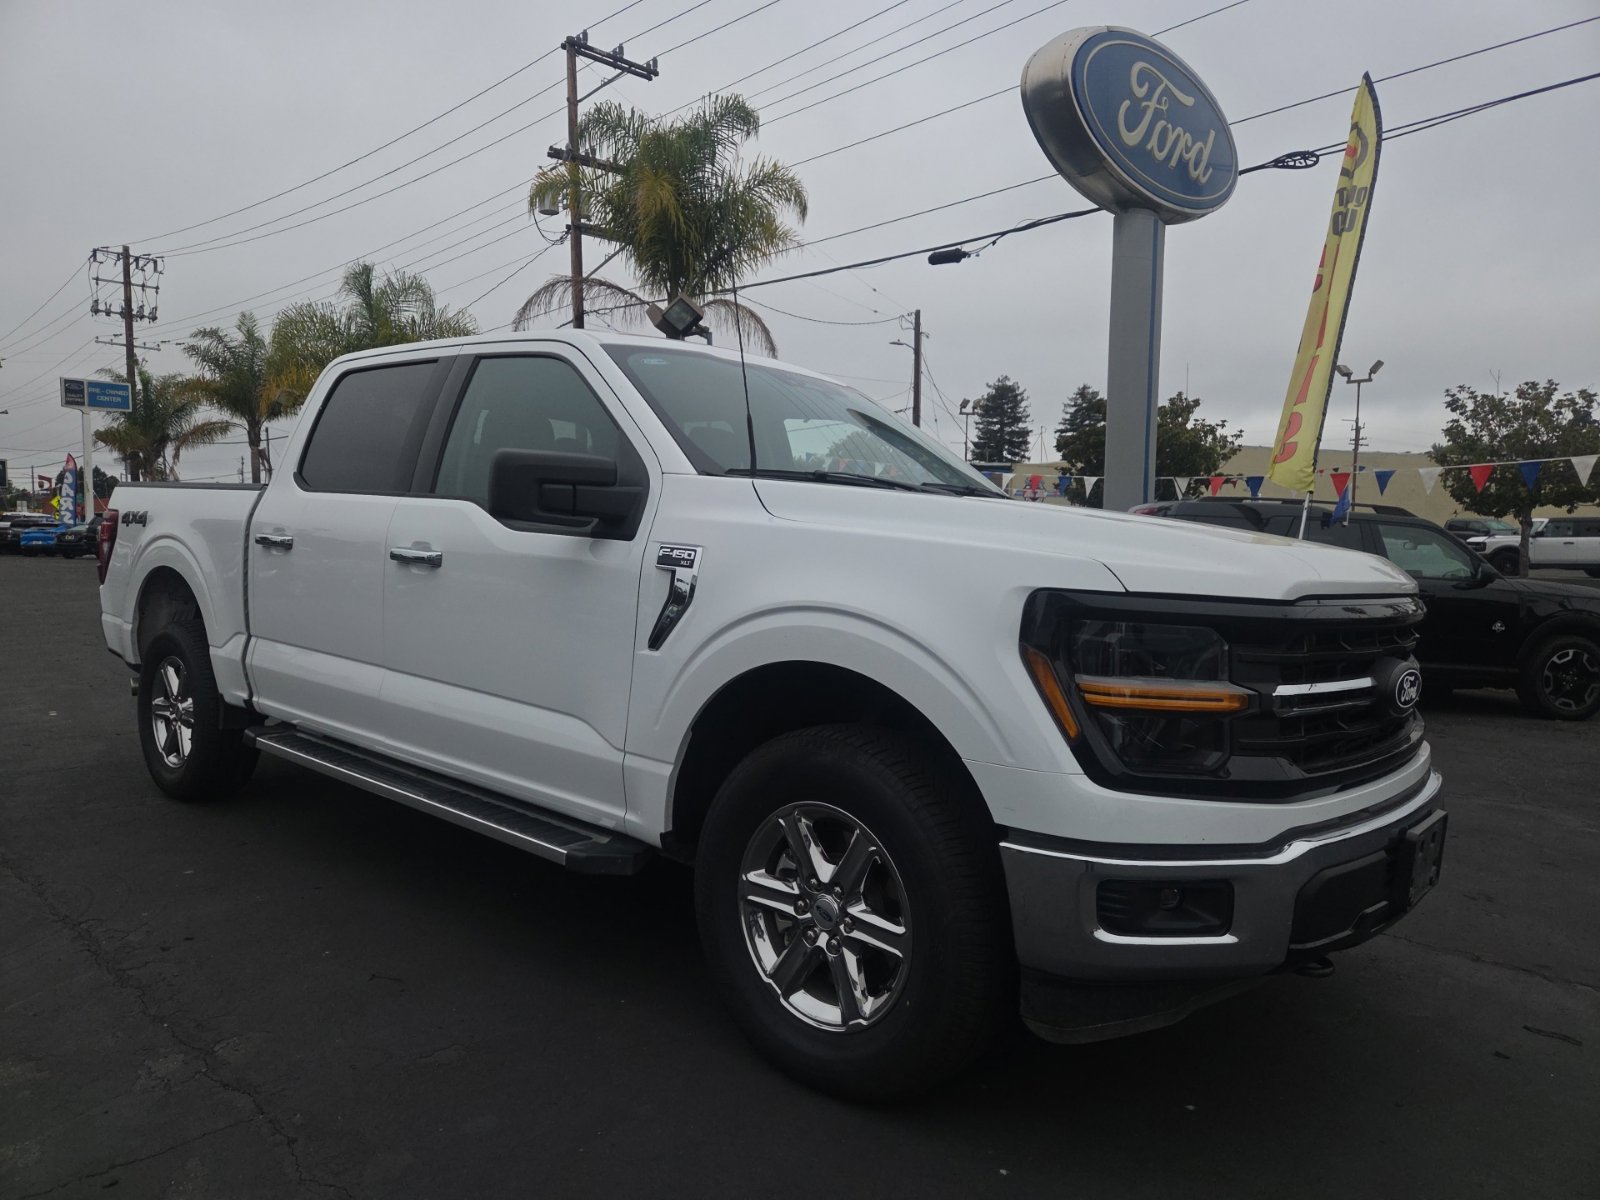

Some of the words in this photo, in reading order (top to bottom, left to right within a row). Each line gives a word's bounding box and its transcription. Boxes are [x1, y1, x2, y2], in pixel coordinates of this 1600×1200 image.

[1117, 61, 1216, 185] Ford
[96, 395, 121, 403] CENTER
[659, 549, 695, 559] F-150
[1401, 676, 1418, 702] Ford
